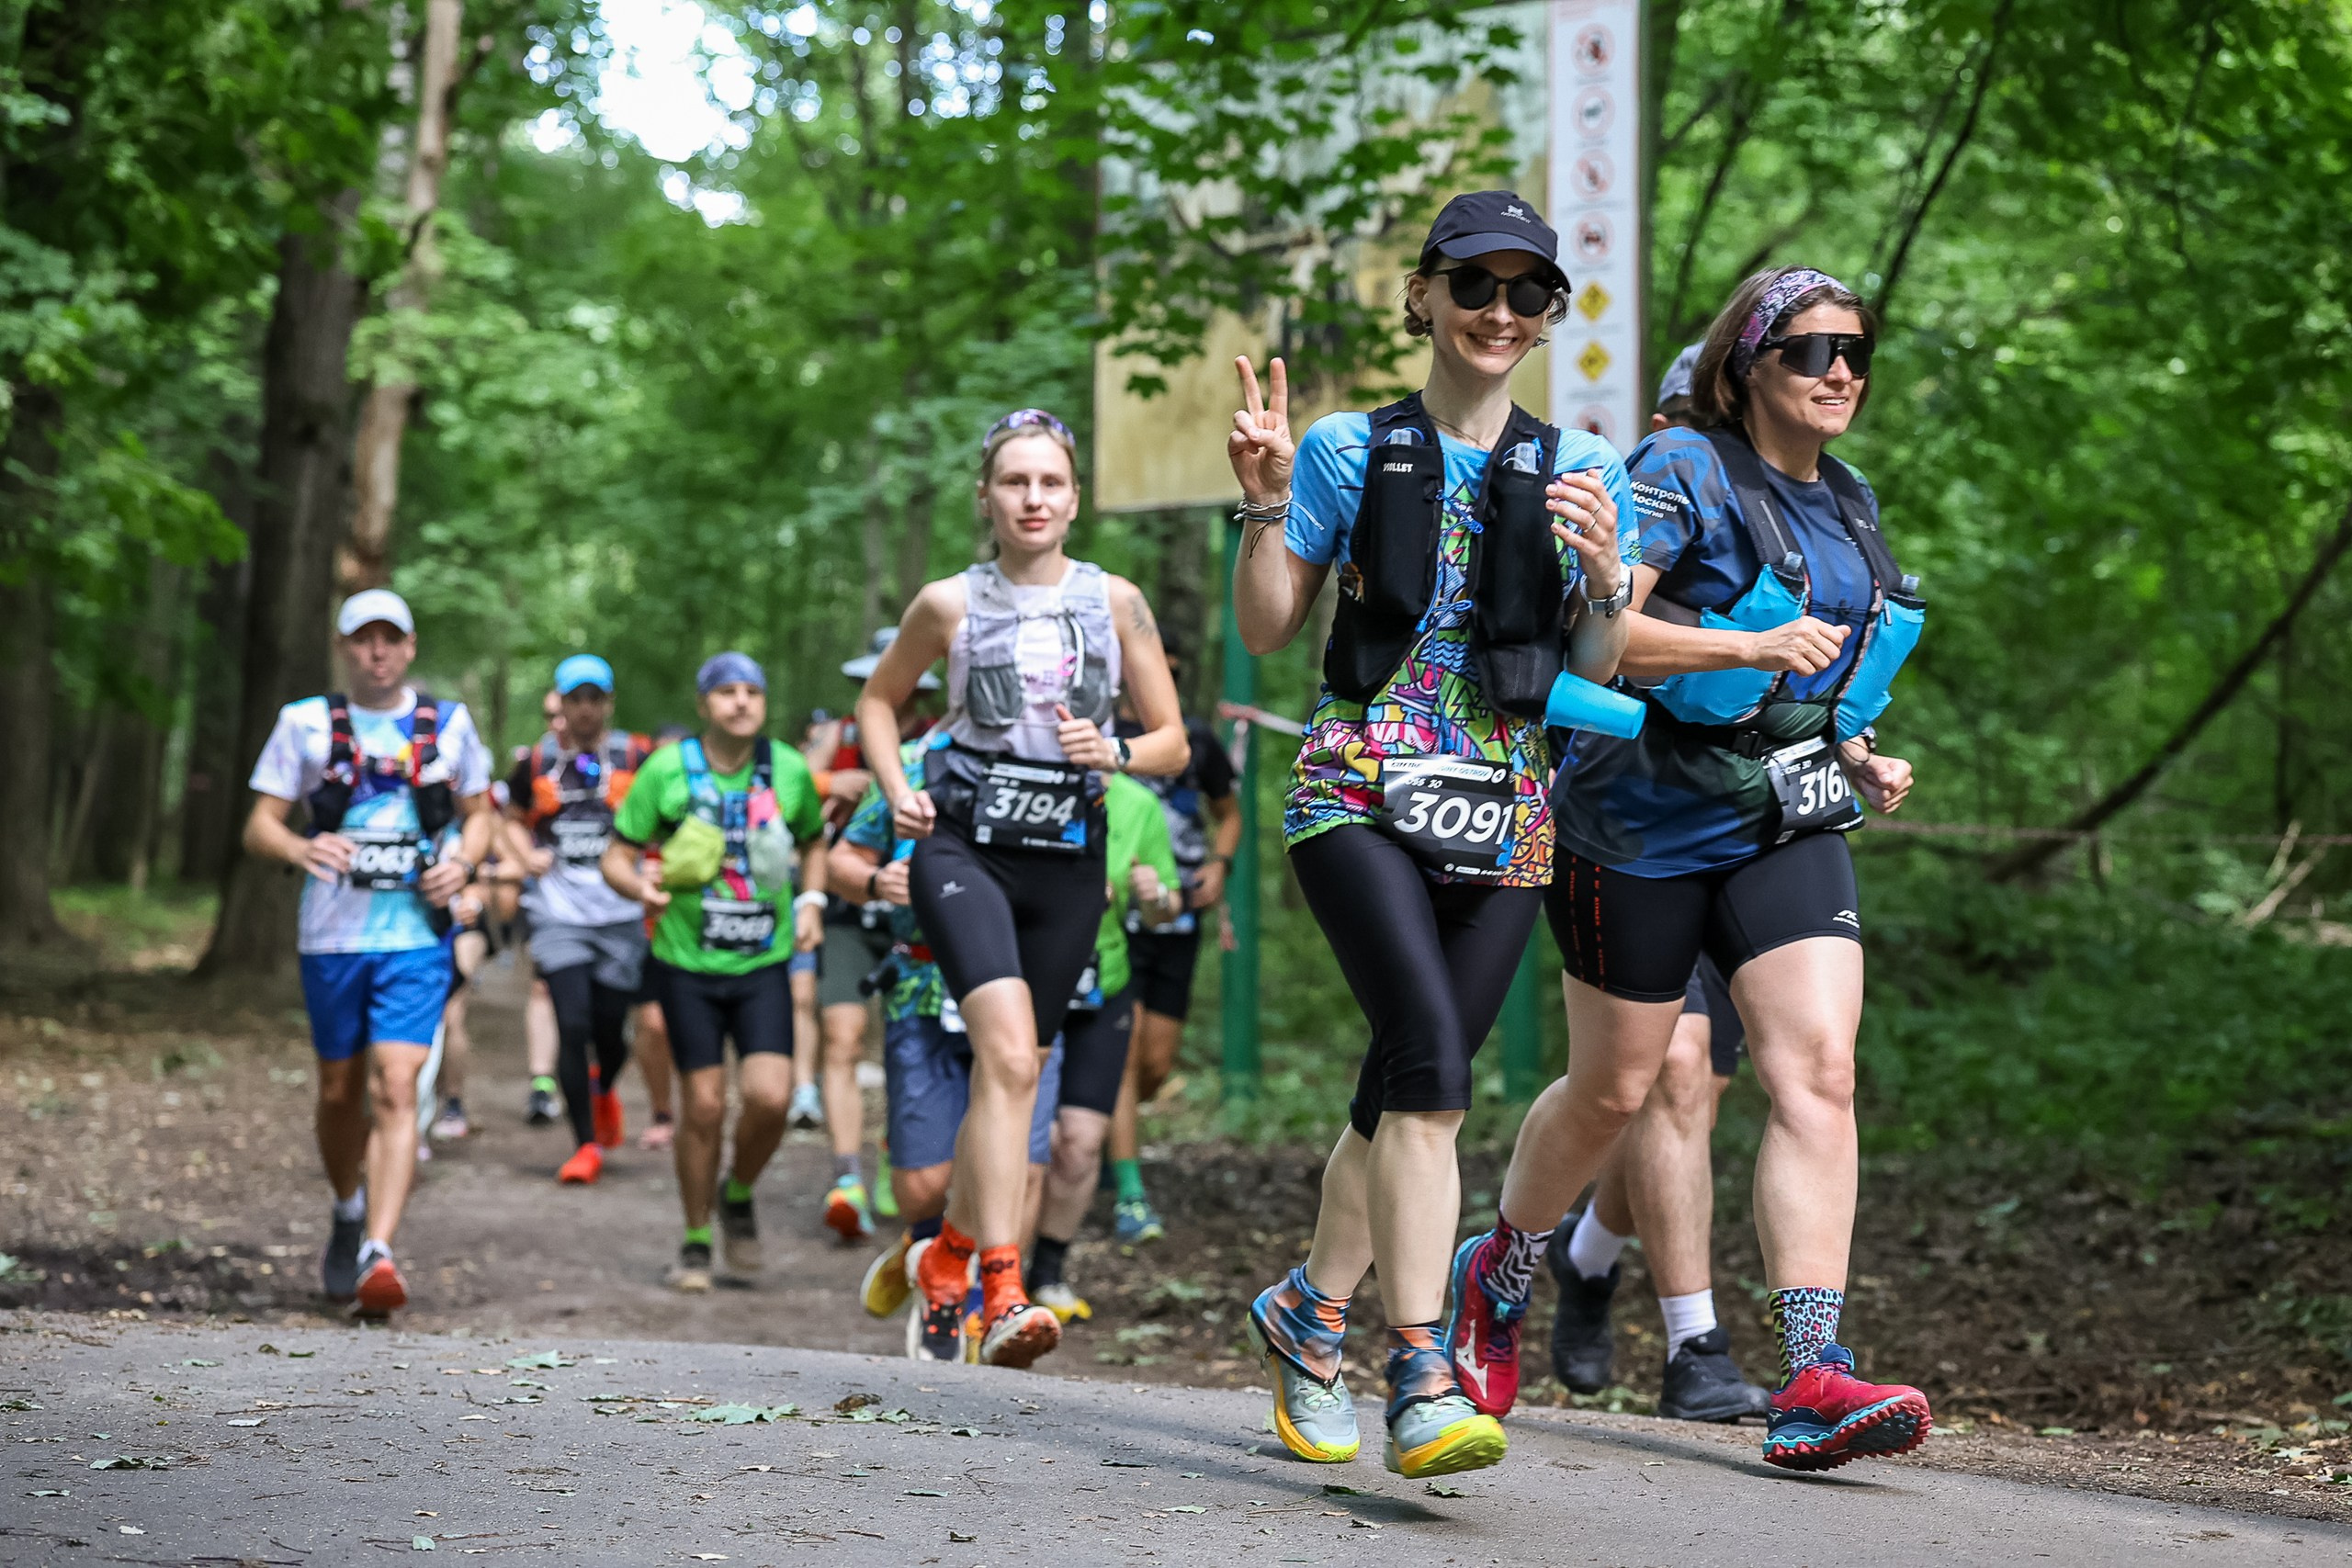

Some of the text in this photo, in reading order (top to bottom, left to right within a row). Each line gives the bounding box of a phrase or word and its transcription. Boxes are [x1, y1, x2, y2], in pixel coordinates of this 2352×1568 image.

[1383, 462, 1413, 472] MILLET
[1630, 480, 1690, 504] Контроль
[985, 786, 1078, 827] 3194
[1393, 791, 1515, 845] 3091
